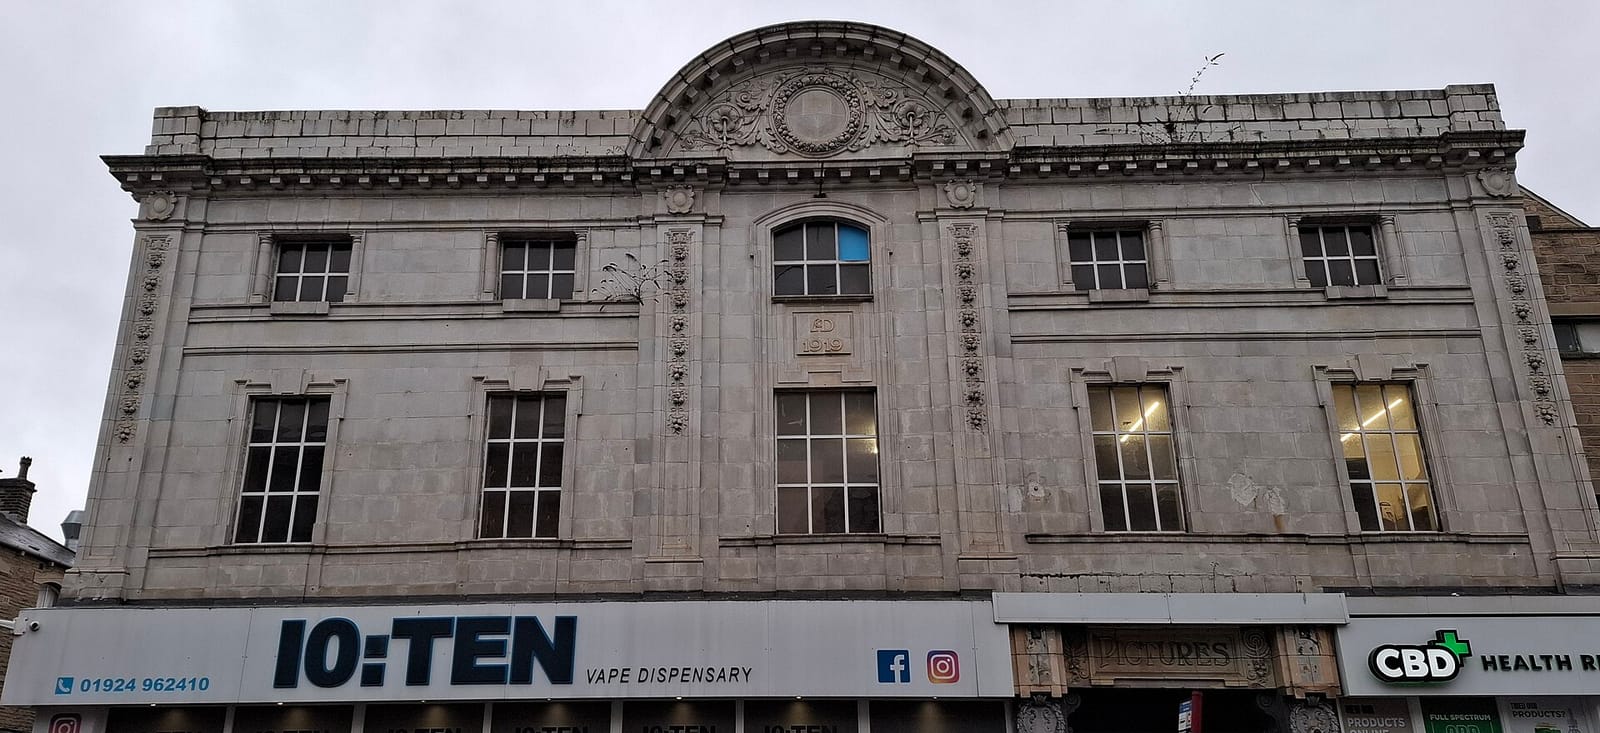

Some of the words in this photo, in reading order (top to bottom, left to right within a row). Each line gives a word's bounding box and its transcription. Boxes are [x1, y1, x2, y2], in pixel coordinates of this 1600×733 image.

[803, 339, 843, 353] 1919
[1098, 637, 1230, 668] PICTURES
[1376, 648, 1456, 678] CBD
[1480, 654, 1573, 671] HEALTH
[586, 668, 631, 684] VAPE
[637, 667, 752, 683] DISPENSARY
[80, 678, 136, 692] 01924
[142, 677, 210, 691] 962410
[1450, 713, 1491, 721] SPECTRUM
[1512, 710, 1566, 718] PRODUCTS?
[1347, 717, 1406, 728] PRODUCTS
